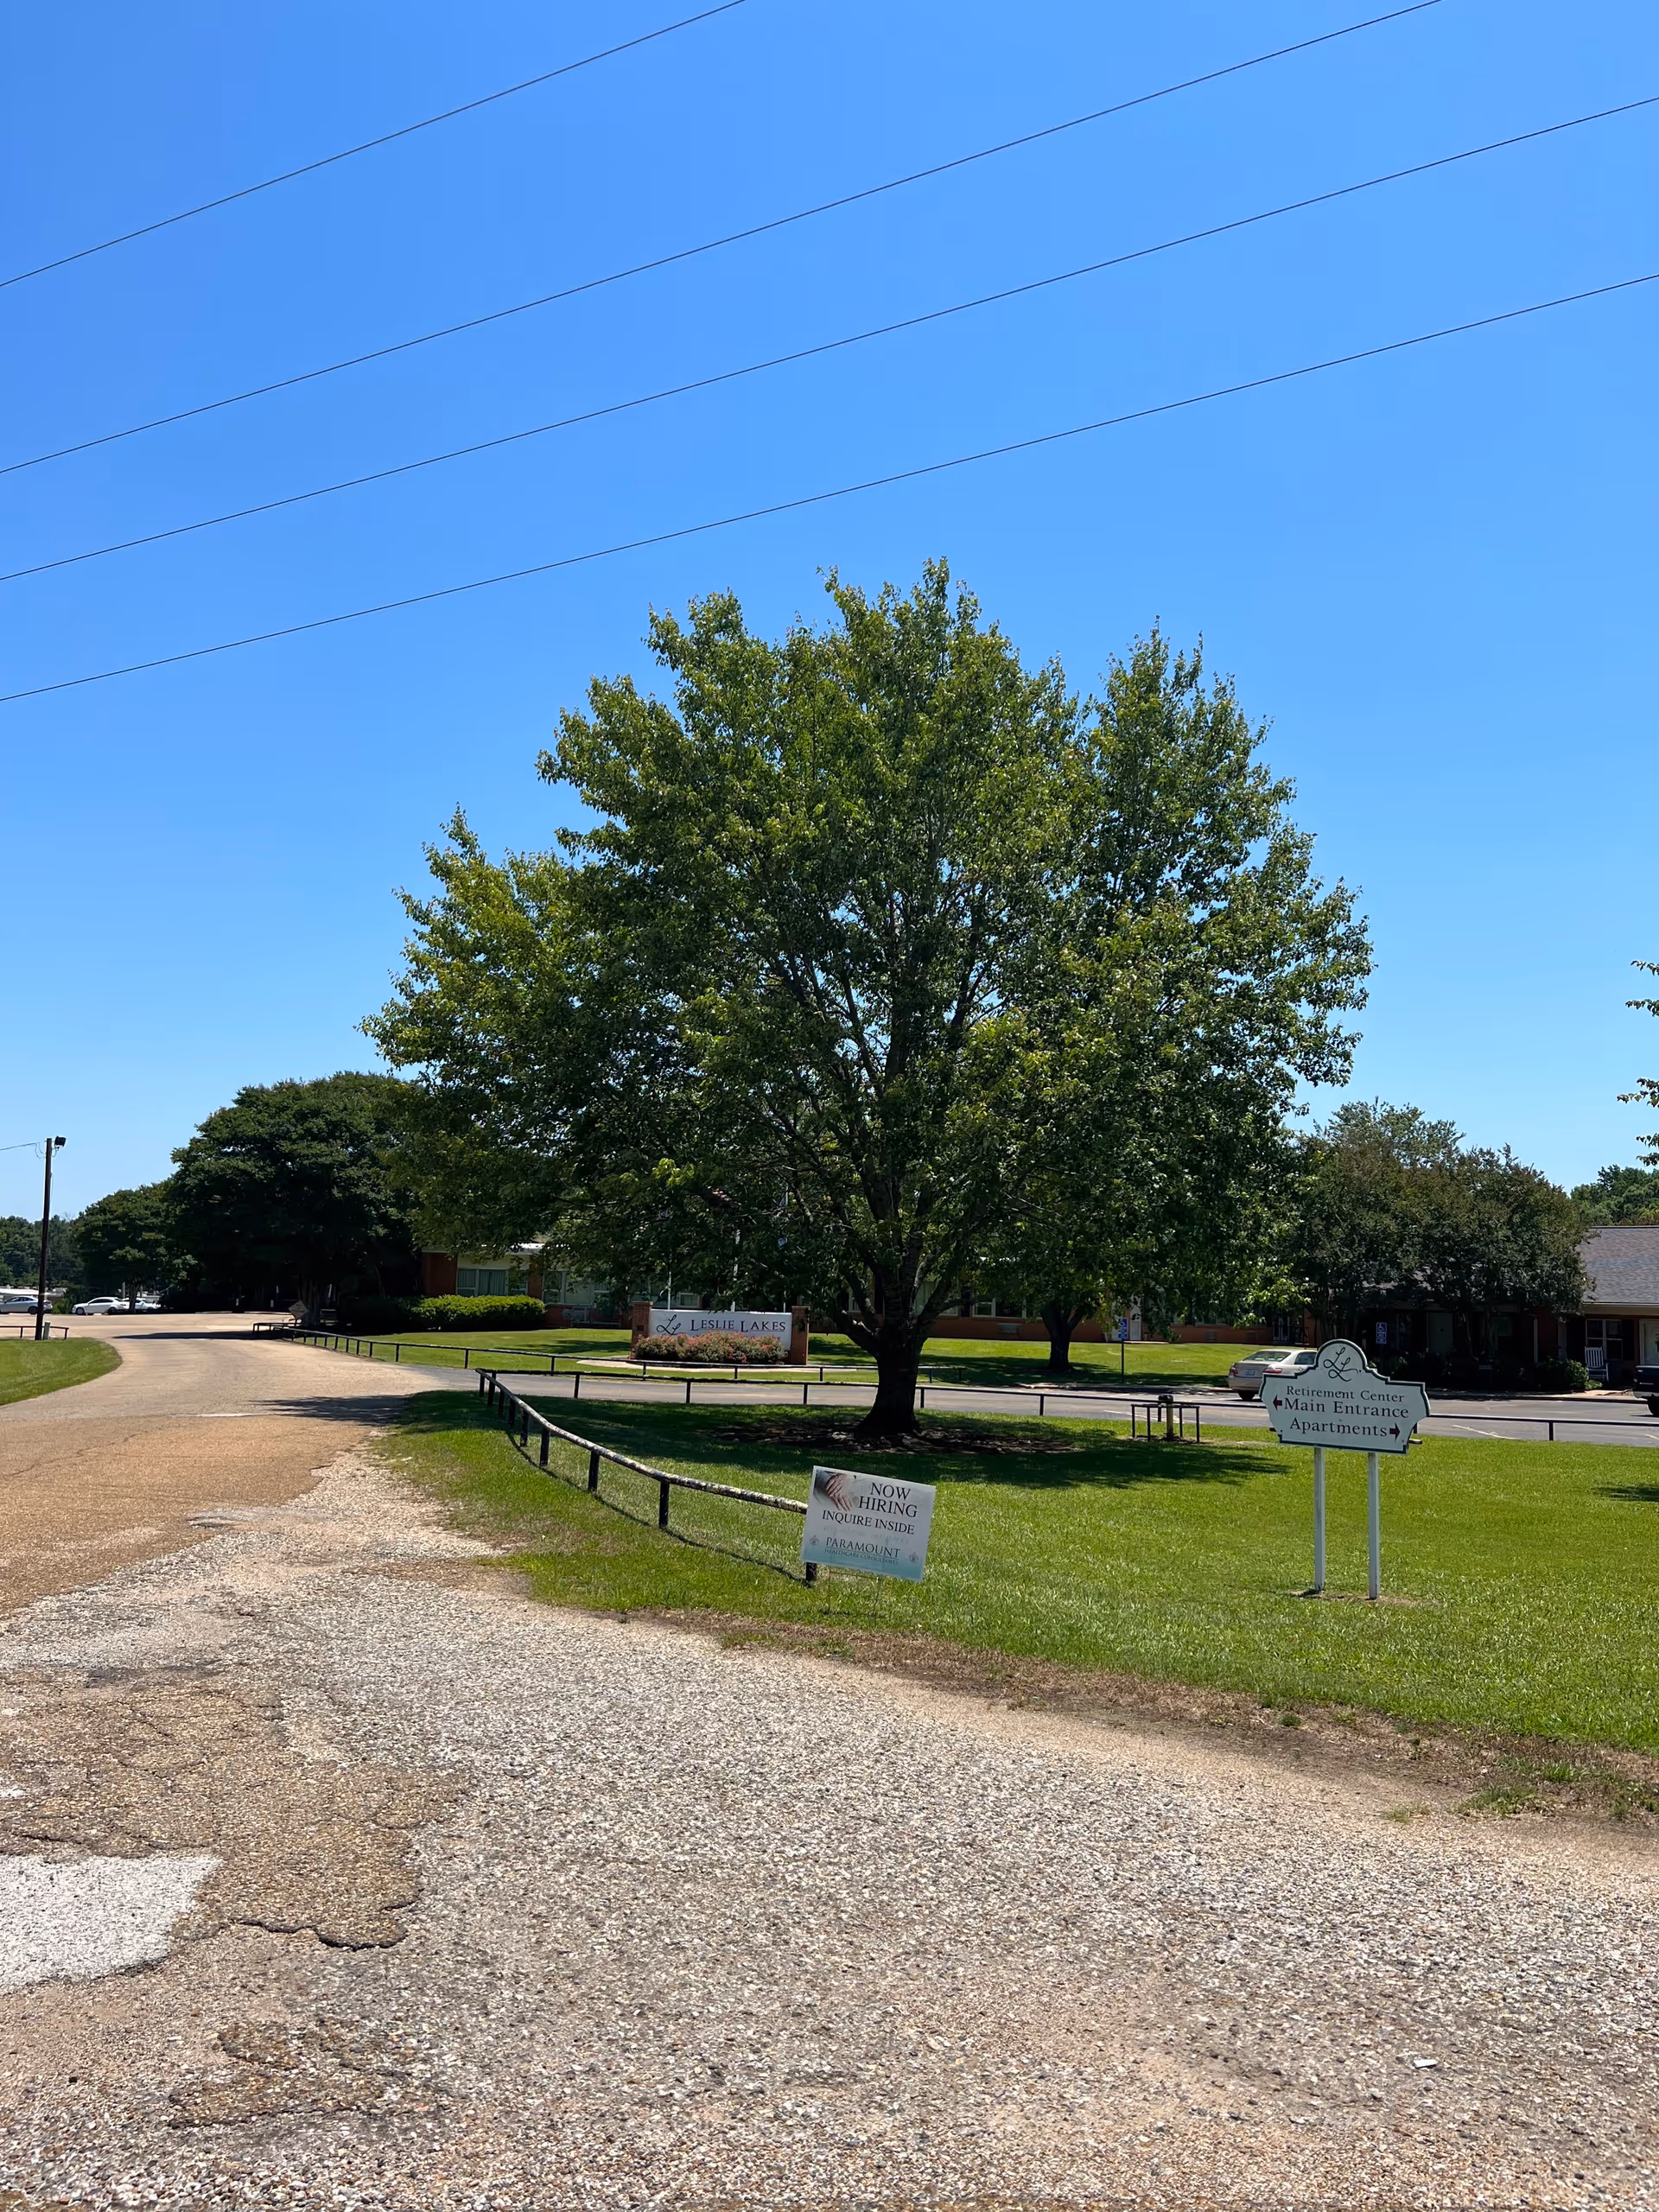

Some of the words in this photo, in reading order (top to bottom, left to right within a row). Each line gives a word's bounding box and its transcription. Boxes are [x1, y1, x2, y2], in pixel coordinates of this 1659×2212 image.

[691, 1319, 734, 1331] LESLIE
[741, 1320, 786, 1332] LAKES
[1287, 1385, 1355, 1400] Retirement
[1360, 1389, 1405, 1403] Center
[1284, 1397, 1325, 1413] Main
[1332, 1401, 1409, 1419] Entrance
[1289, 1418, 1388, 1437] Apartments
[870, 1482, 912, 1501] NOW
[858, 1495, 918, 1518] HIRING
[822, 1510, 873, 1527] INQUIRE
[874, 1518, 915, 1535] INSIDE
[824, 1548, 860, 1559] HEALTHCARE
[860, 1554, 899, 1565] CONSULTANTS
[825, 1536, 901, 1558] PARAMOUNT
